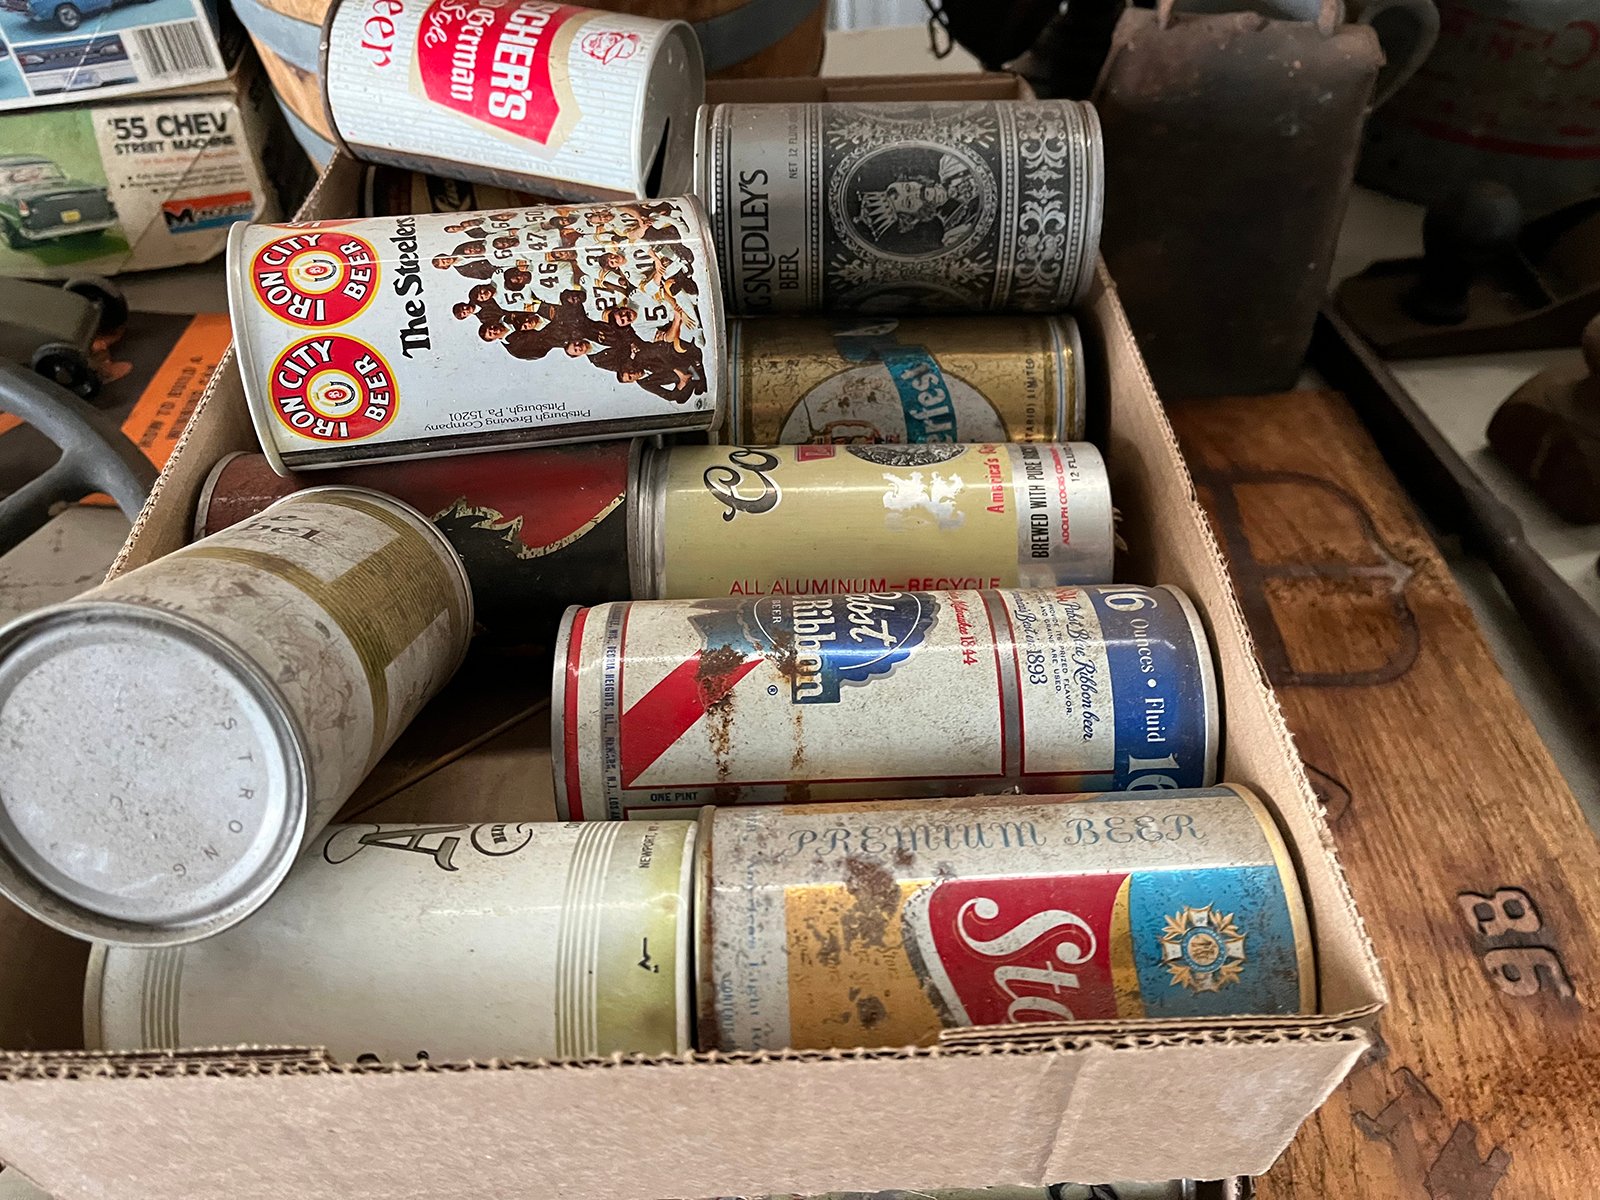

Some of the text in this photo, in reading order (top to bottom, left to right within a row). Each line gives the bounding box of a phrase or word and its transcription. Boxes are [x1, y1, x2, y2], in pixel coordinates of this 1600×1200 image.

[108, 111, 229, 141] '55 CHEV
[114, 134, 237, 156] STREET MACHINE
[788, 146, 798, 157] 12
[788, 162, 798, 180] NET
[261, 233, 322, 267] CITY
[342, 240, 372, 302] BEER
[537, 262, 558, 289] 46
[778, 247, 800, 291] BEER
[258, 270, 327, 322] IRON
[389, 216, 432, 360] The Steelers
[277, 339, 335, 391] CITY
[353, 353, 391, 424] BEER
[279, 396, 350, 439] IRON
[424, 408, 592, 432] Pittsburgh Brewing Company
[449, 409, 483, 421] 15201
[505, 401, 566, 416] Pittsburgh,
[986, 455, 1006, 515] America's
[1024, 459, 1045, 482] PURE
[1070, 470, 1081, 483] 12
[1028, 483, 1048, 510] WITH
[1056, 475, 1069, 505] COORS
[1031, 513, 1050, 559] BREWED
[1061, 506, 1071, 546] ADOLPH
[729, 579, 766, 596] ALL
[792, 598, 838, 702] Ribbon
[959, 637, 979, 667] 1844
[1050, 648, 1059, 665] ARE
[1058, 645, 1069, 674] PRIZED
[1026, 649, 1048, 685] 1893
[1053, 667, 1063, 694] USED.
[1072, 653, 1099, 709] Ribbon
[1129, 618, 1167, 743] Ounces Fluid
[1063, 678, 1074, 716] FLAVOR.
[1082, 710, 1101, 742] beer
[650, 791, 699, 802] ONE PINT
[782, 819, 1048, 858] PREMIUM
[1063, 813, 1207, 847] BEER
